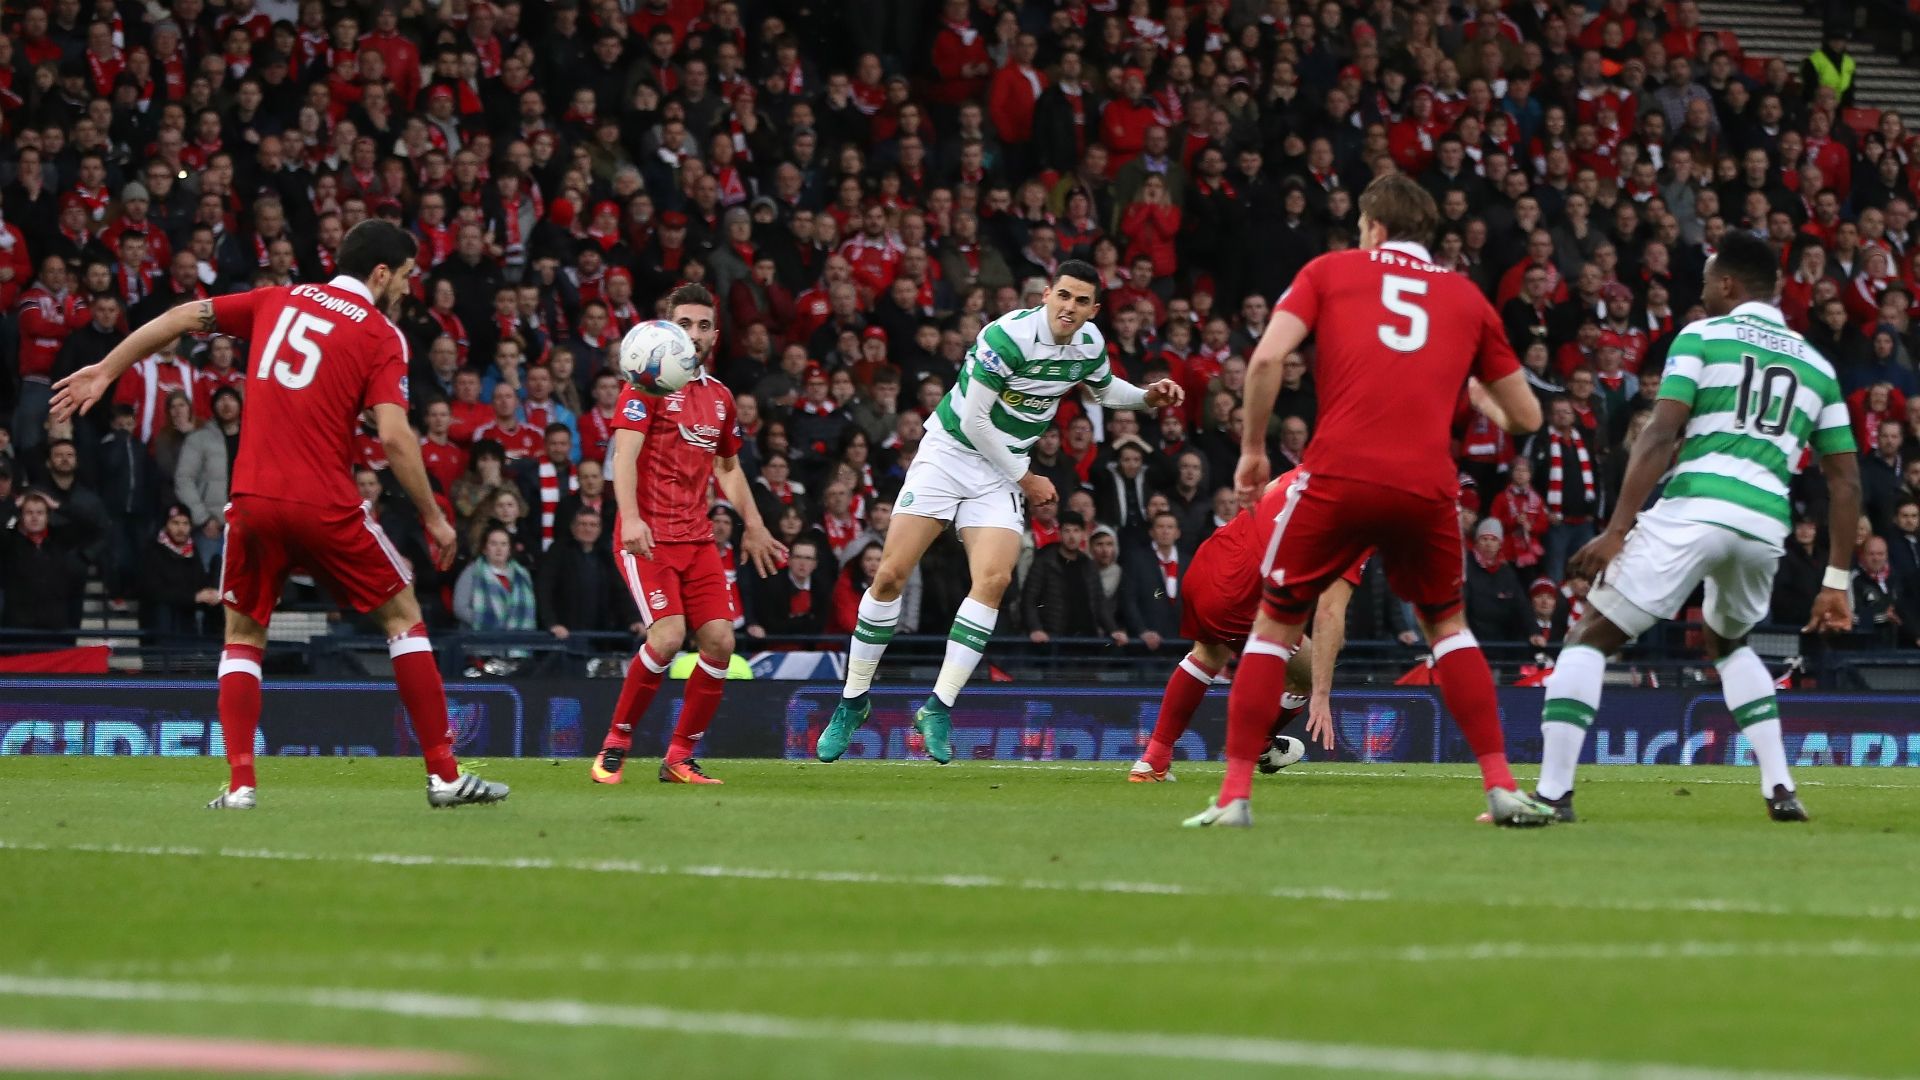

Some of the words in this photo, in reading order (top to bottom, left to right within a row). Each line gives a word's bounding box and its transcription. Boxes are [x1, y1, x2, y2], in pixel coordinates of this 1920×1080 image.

[290, 284, 369, 323] O'CONNOR
[1378, 273, 1429, 353] 5
[256, 305, 335, 390] 15
[1734, 353, 1798, 437] 10
